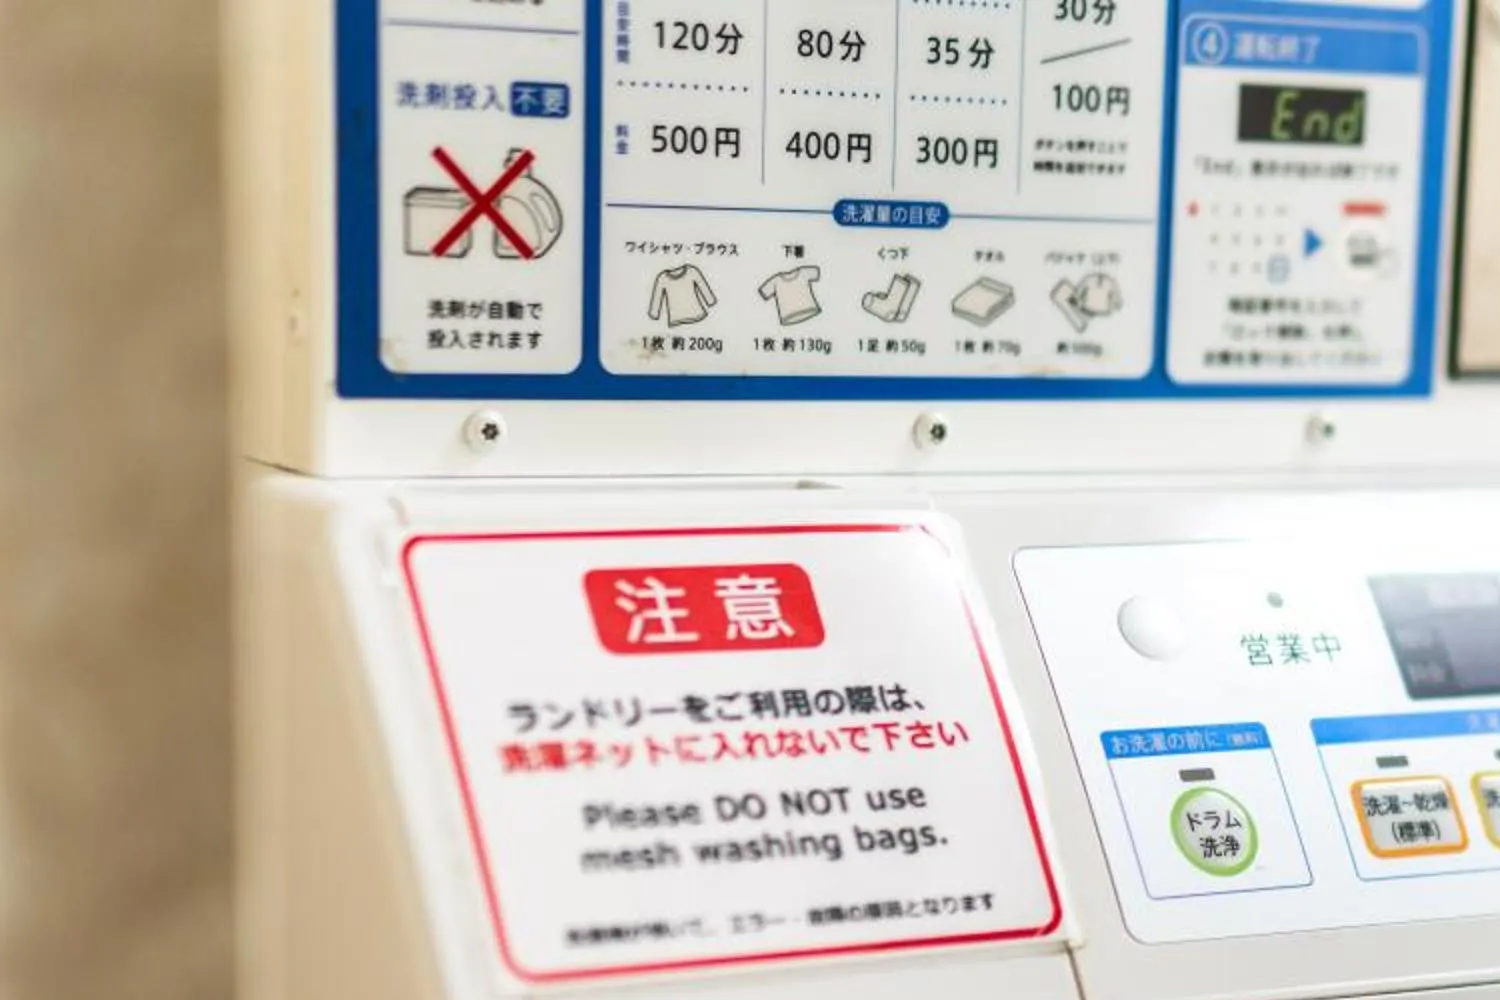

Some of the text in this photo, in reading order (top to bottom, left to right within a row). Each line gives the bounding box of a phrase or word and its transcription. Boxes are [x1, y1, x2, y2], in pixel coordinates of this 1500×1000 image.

[1054, 0, 1117, 25] 30分
[653, 20, 744, 55] 120分
[797, 29, 867, 62] 80分
[926, 37, 996, 69] 35分
[1053, 83, 1131, 116] 100円
[1272, 90, 1364, 145] End
[651, 125, 741, 158] 500円
[785, 132, 873, 163] 400円
[916, 138, 999, 168] 300円
[841, 203, 941, 225] 洗濯量の目安
[625, 241, 740, 256] ワイシャツ・ブラウス
[877, 247, 910, 260] くつ下
[427, 298, 543, 319] 洗剤が自動で
[427, 328, 544, 349] 投入されます
[613, 573, 797, 646] 注意
[1240, 632, 1342, 666] 営業中
[498, 720, 969, 774] 洗濯ネットに入れないで下さい
[1110, 729, 1224, 755] お洗濯の前に
[582, 786, 927, 831] Please DO NOT use
[1185, 809, 1243, 832] ドラム
[581, 824, 949, 873] mesh washing bags.
[1200, 834, 1241, 859] 洗浄
